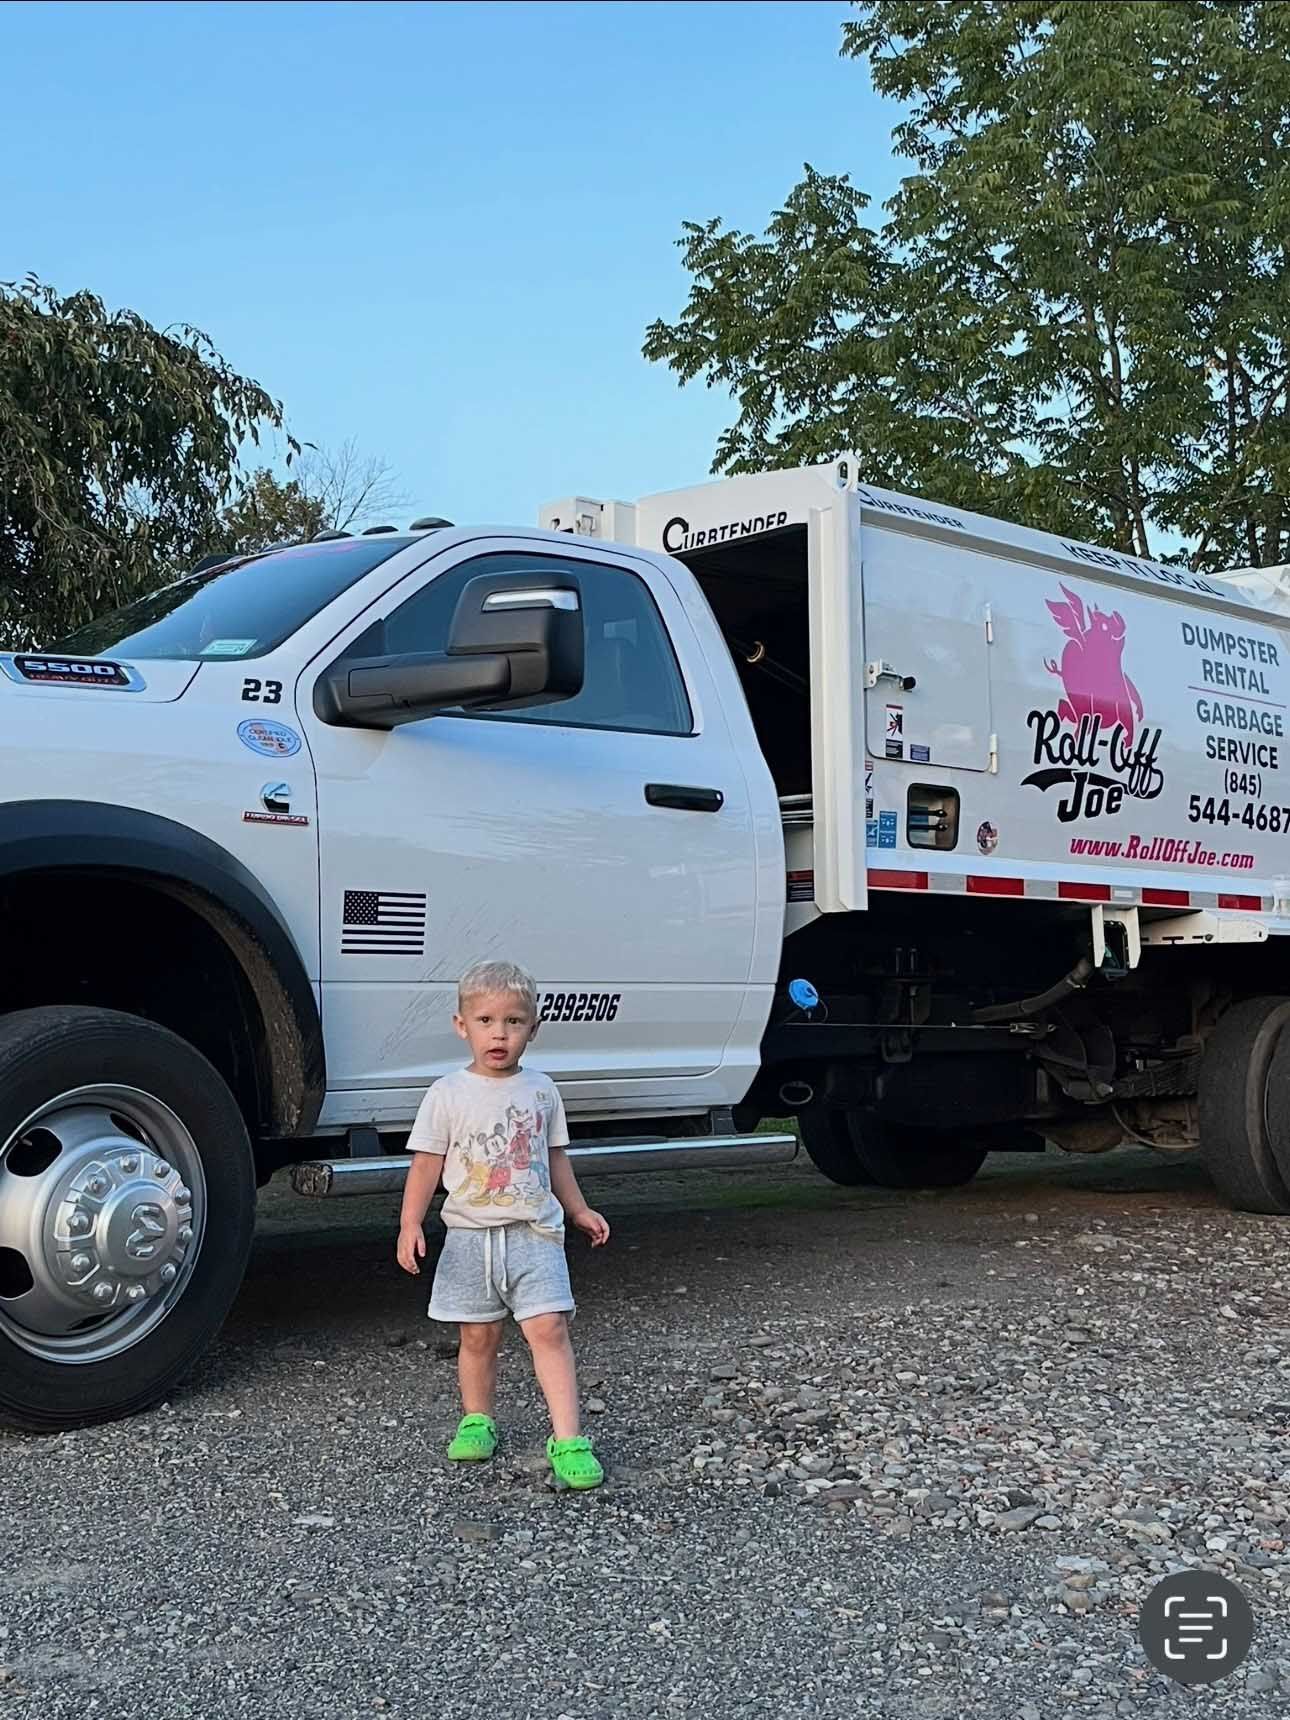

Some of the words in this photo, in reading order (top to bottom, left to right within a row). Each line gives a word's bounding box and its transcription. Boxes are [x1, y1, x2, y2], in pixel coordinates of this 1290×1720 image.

[1060, 542, 1122, 570] KEEP
[1143, 564, 1225, 597] LOCAL
[1181, 622, 1280, 666] DUMPSTER
[24, 660, 116, 675] 5500
[1202, 658, 1270, 694] RENTAL
[241, 678, 283, 705] 23
[1196, 698, 1284, 737] GARBAGE
[1026, 710, 1164, 799] Roll-Off
[1206, 735, 1279, 769] SERVICE
[1057, 771, 1123, 823] Joe
[1224, 768, 1262, 799] (845)
[1188, 794, 1290, 834] 544-4687
[1070, 834, 1255, 869] www.RollOffJoe.com
[540, 993, 621, 1022] 2992506
